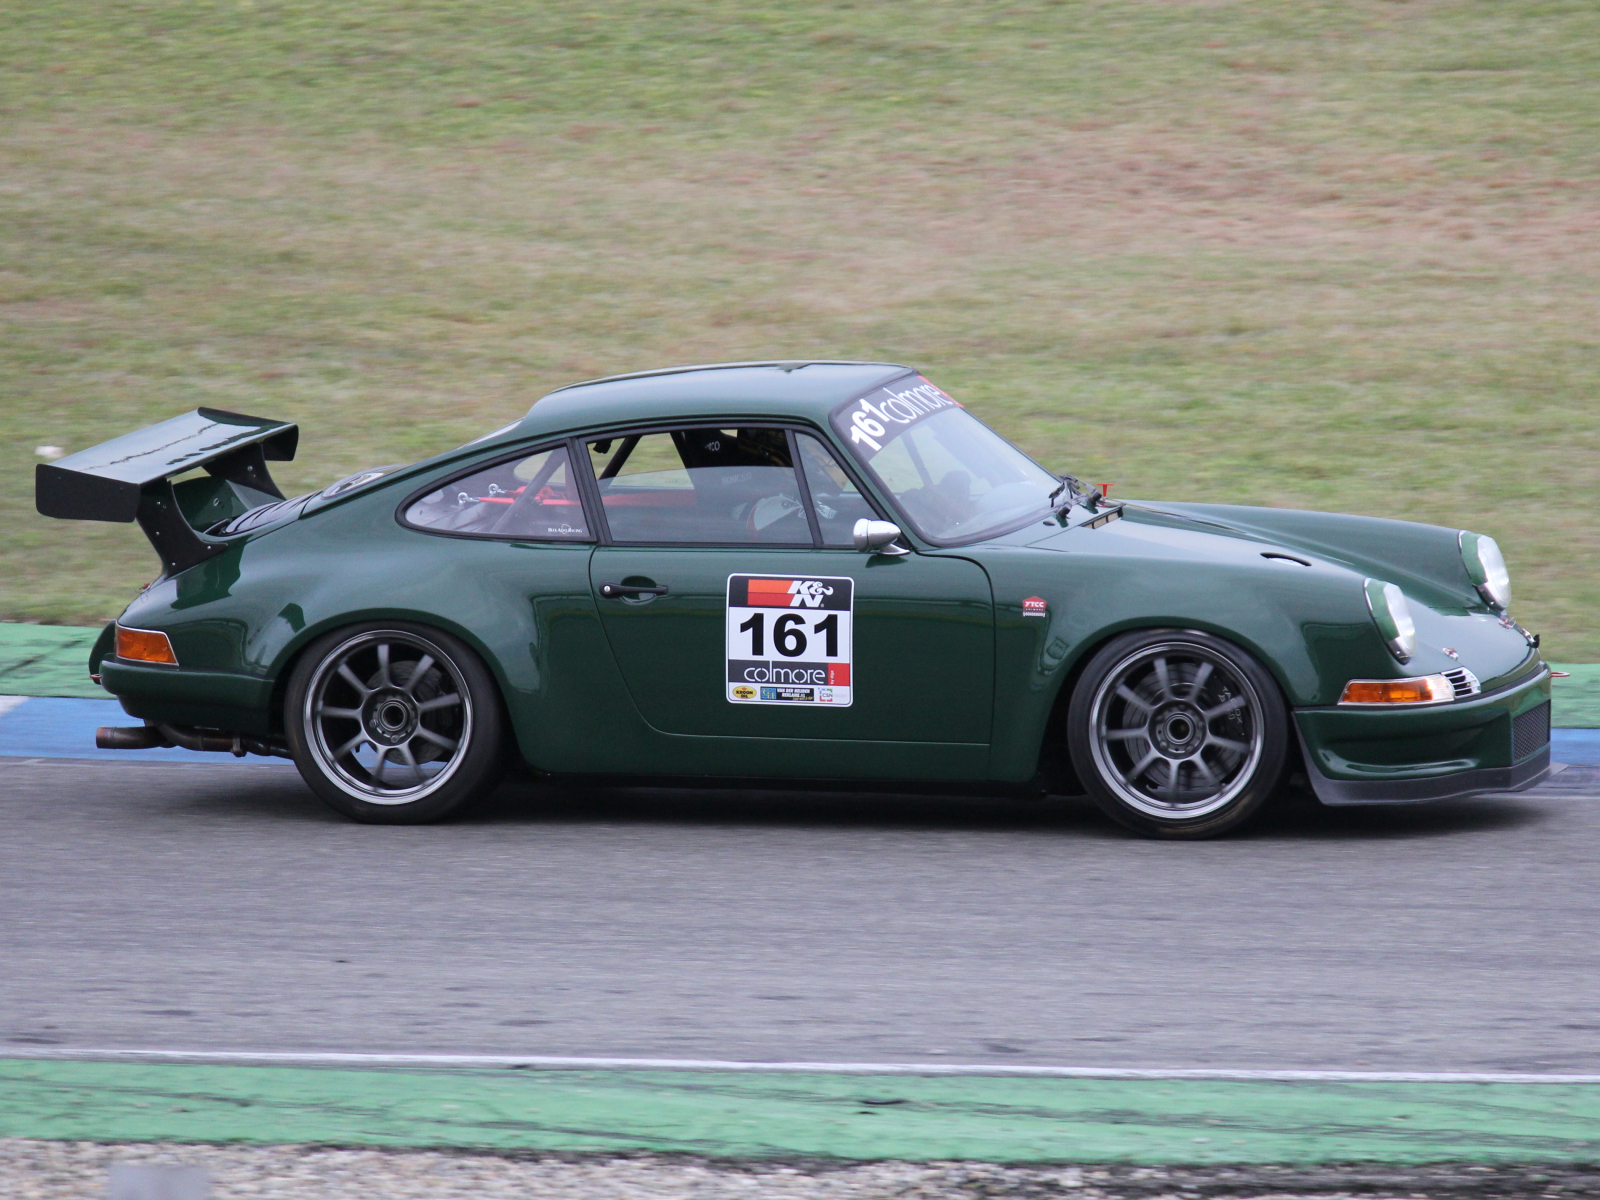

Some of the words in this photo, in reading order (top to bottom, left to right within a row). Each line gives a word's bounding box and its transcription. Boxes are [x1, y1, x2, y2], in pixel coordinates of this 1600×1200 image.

[850, 398, 891, 451] 161
[880, 384, 953, 424] colmore
[787, 580, 834, 607] K&N
[740, 613, 838, 657] 161
[744, 660, 826, 684] colmore
